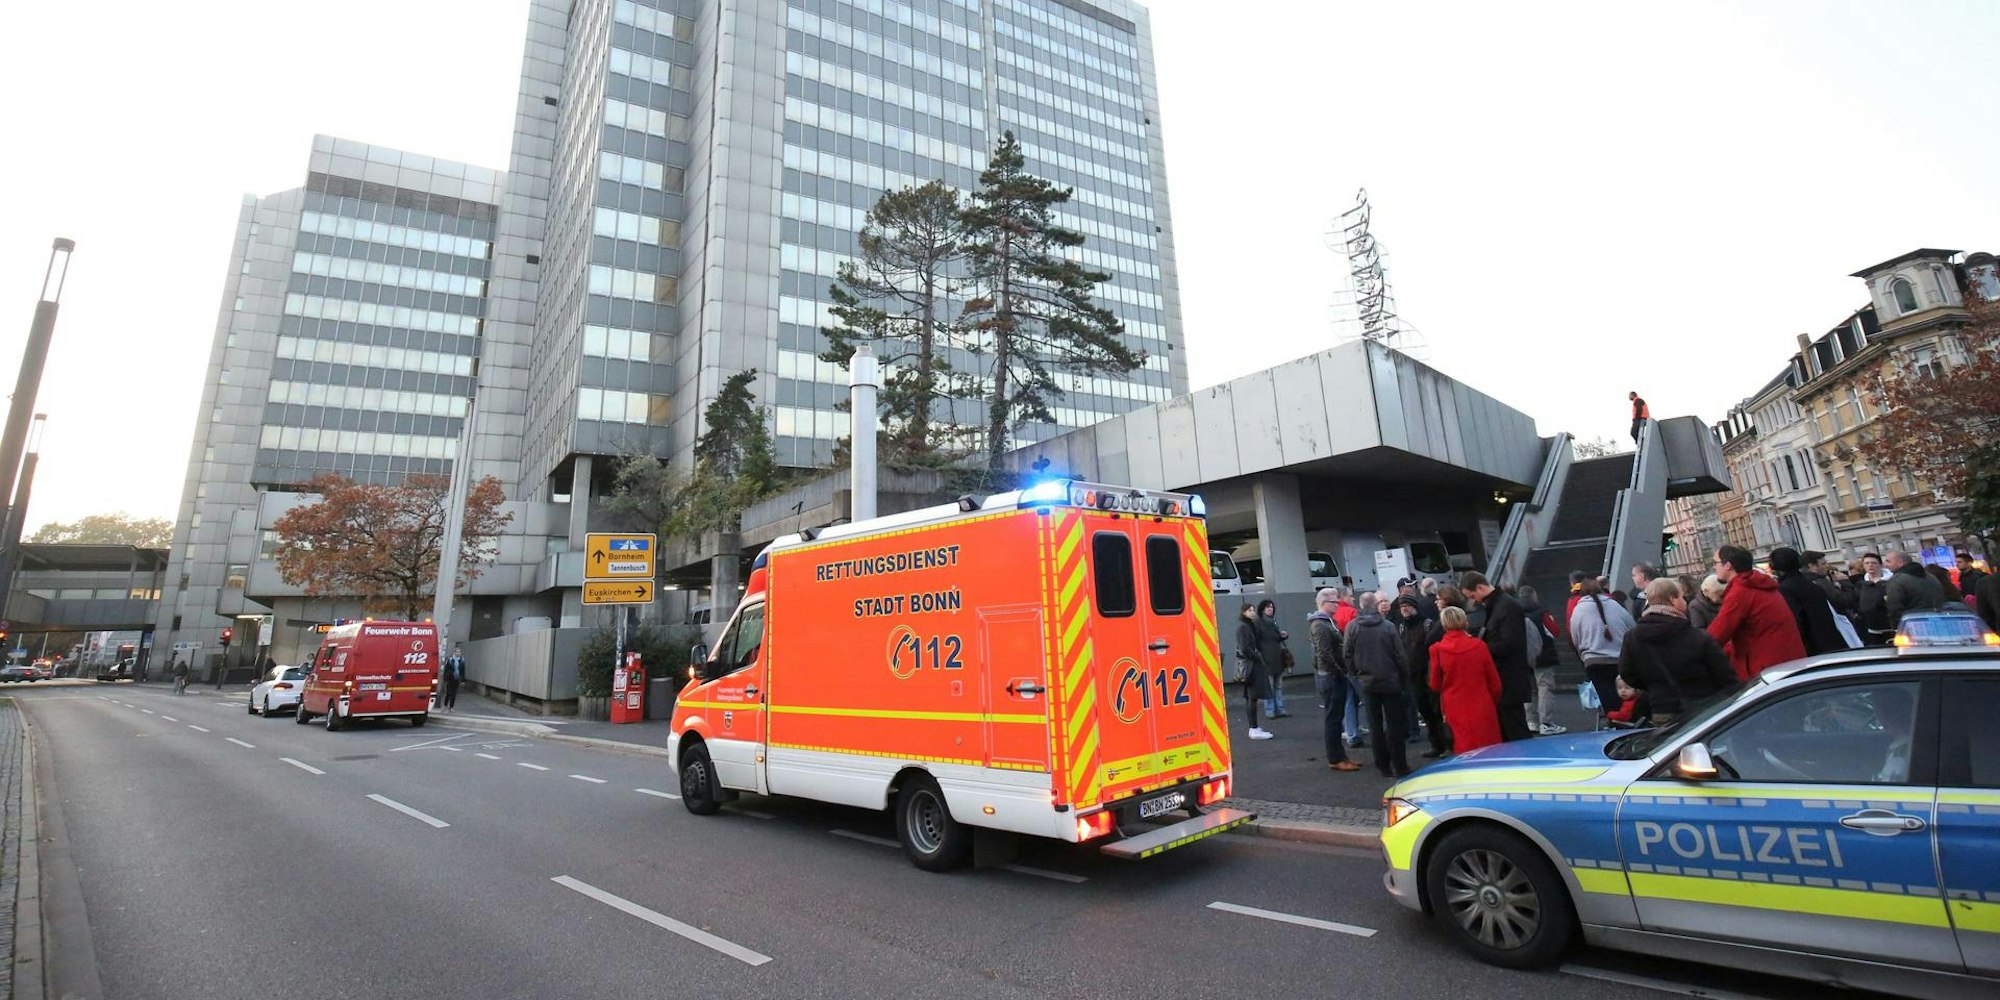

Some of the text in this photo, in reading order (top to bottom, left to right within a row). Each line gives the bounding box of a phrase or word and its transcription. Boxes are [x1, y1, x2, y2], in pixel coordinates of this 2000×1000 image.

[816, 545, 959, 581] RETTUNGSDIENST
[854, 590, 961, 617] STADT BONN
[365, 627, 433, 636] Feuerwehr Bonn
[404, 652, 428, 664] 112
[909, 635, 962, 669] 112
[1135, 668, 1190, 709] 112
[1634, 821, 1844, 868] POLIZEI
